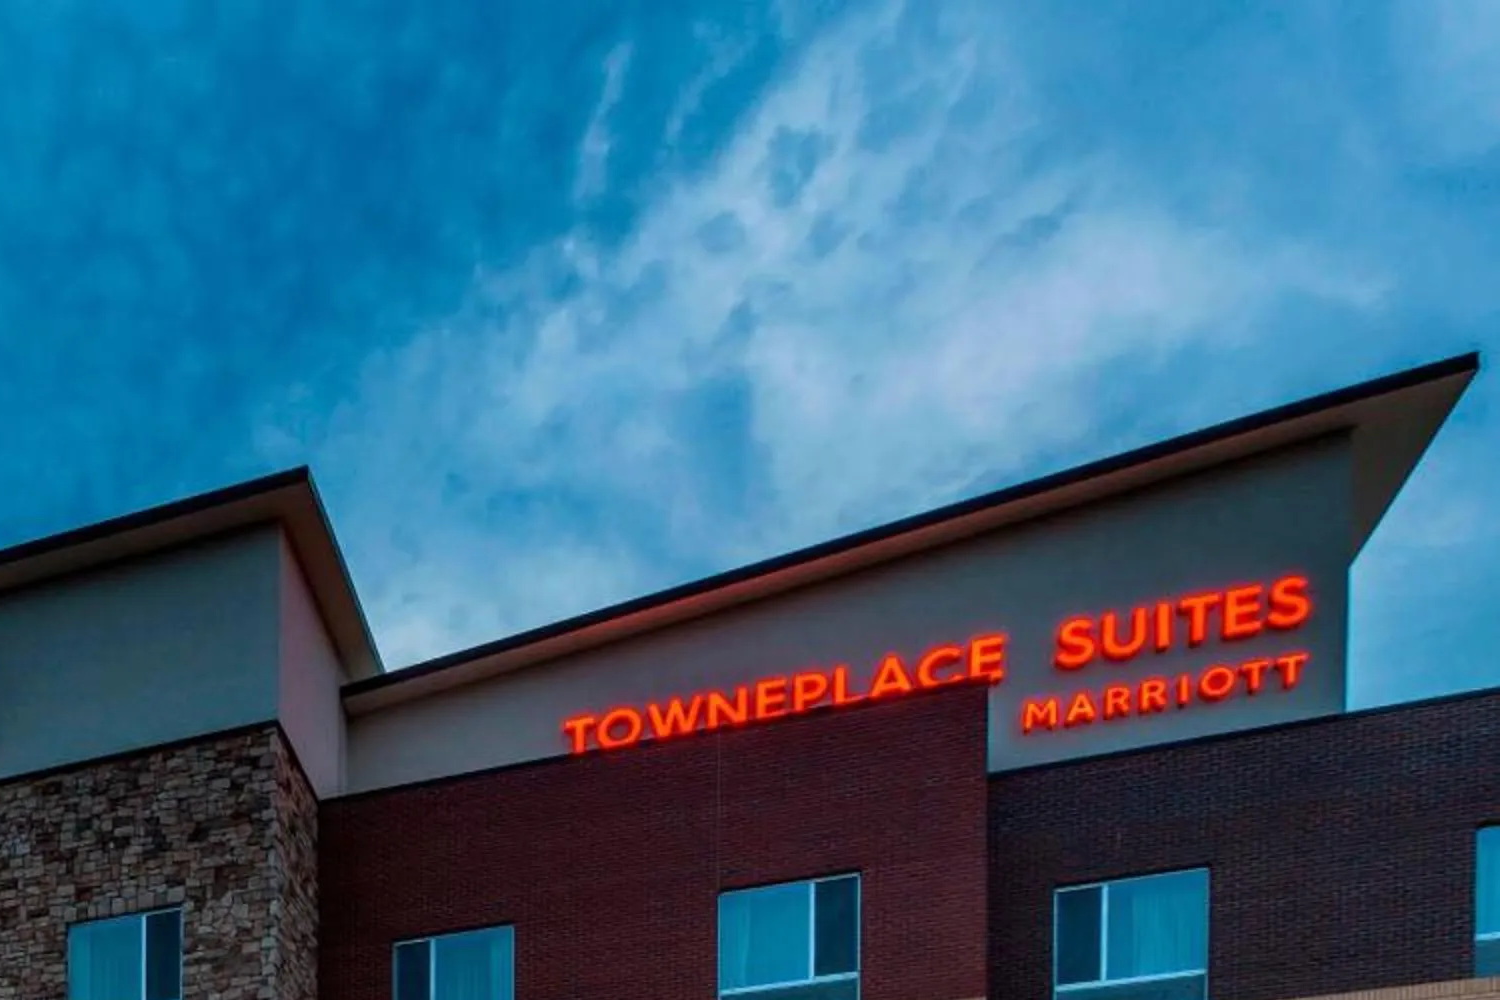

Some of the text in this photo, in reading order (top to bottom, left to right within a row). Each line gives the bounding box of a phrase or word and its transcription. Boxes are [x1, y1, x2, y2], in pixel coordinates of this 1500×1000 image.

[564, 577, 1310, 753] TOWNEPLACE SUITES
[1022, 653, 1307, 730] MARRIOTT
